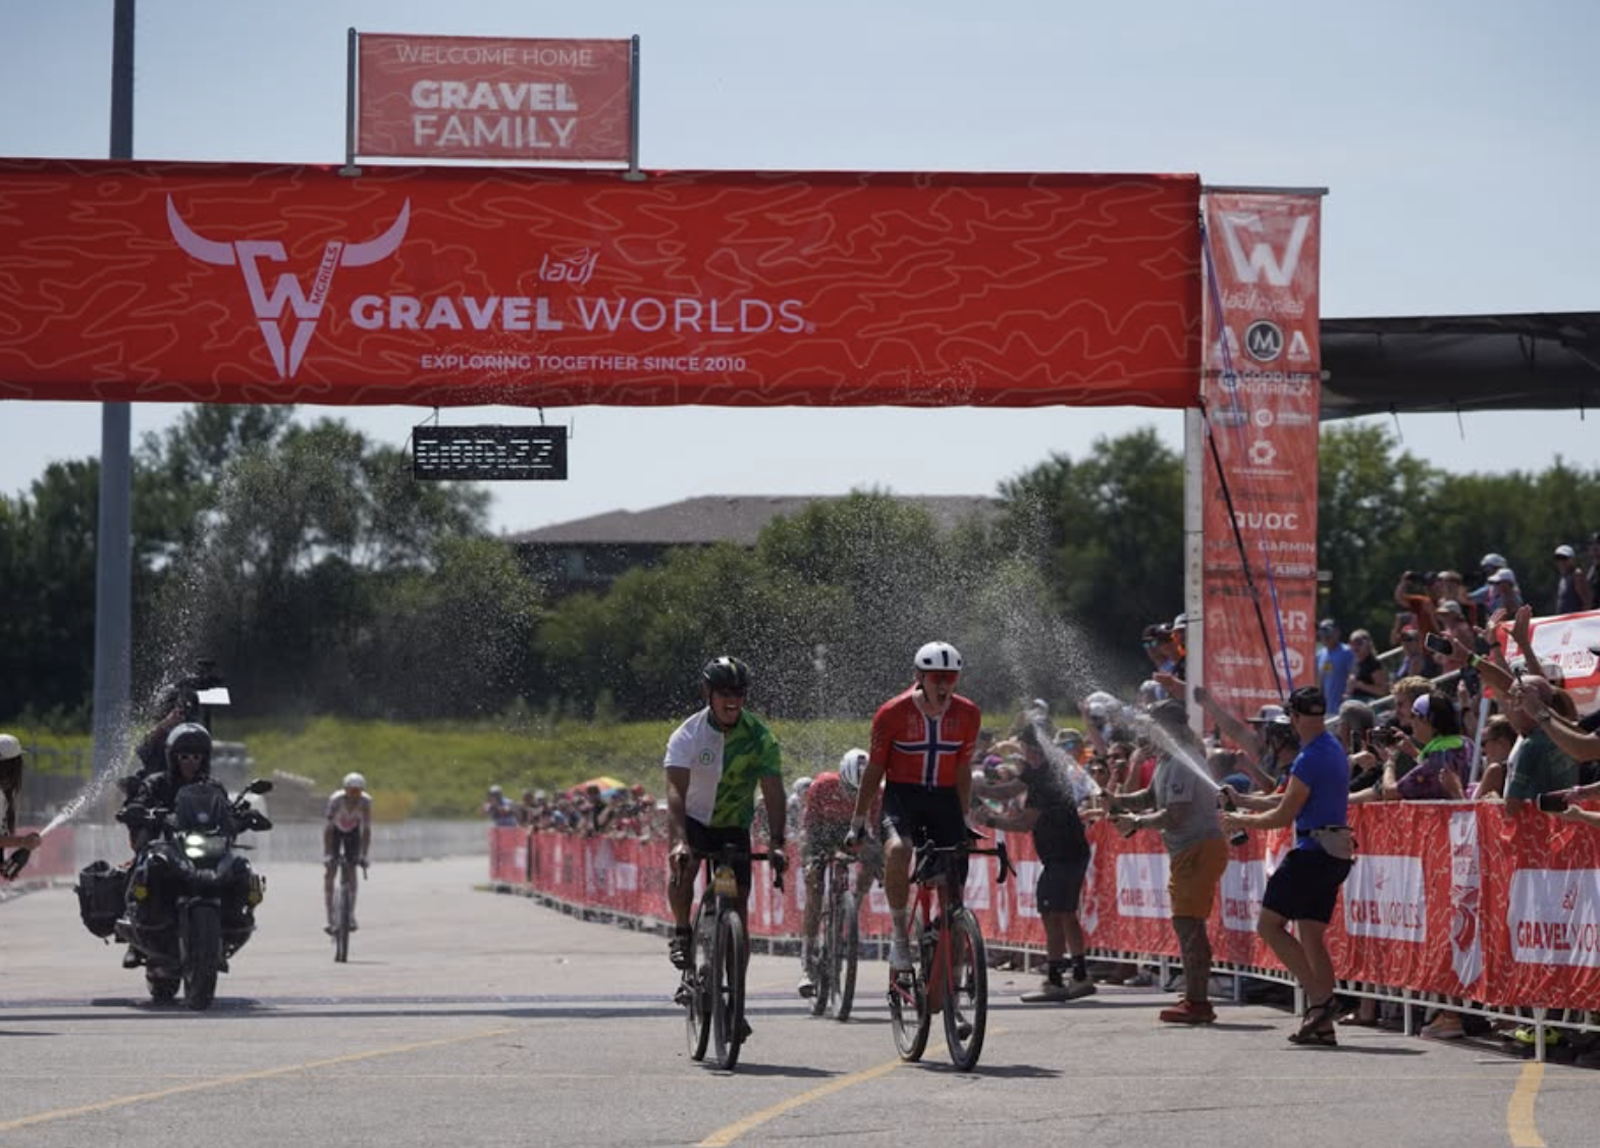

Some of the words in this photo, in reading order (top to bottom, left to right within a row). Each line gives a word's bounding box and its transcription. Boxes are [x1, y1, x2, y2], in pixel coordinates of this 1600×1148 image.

[396, 44, 516, 63] WELCOME
[523, 48, 593, 67] HOME
[411, 80, 578, 111] GRAVEL
[412, 113, 578, 148] FAMILY
[350, 294, 564, 332] GRAVEL
[421, 355, 531, 370] EXPLORING
[537, 356, 638, 371] TOGETHER
[643, 357, 699, 371] SINCE
[704, 357, 748, 372] 2010
[1516, 920, 1571, 950] GRAVEL
